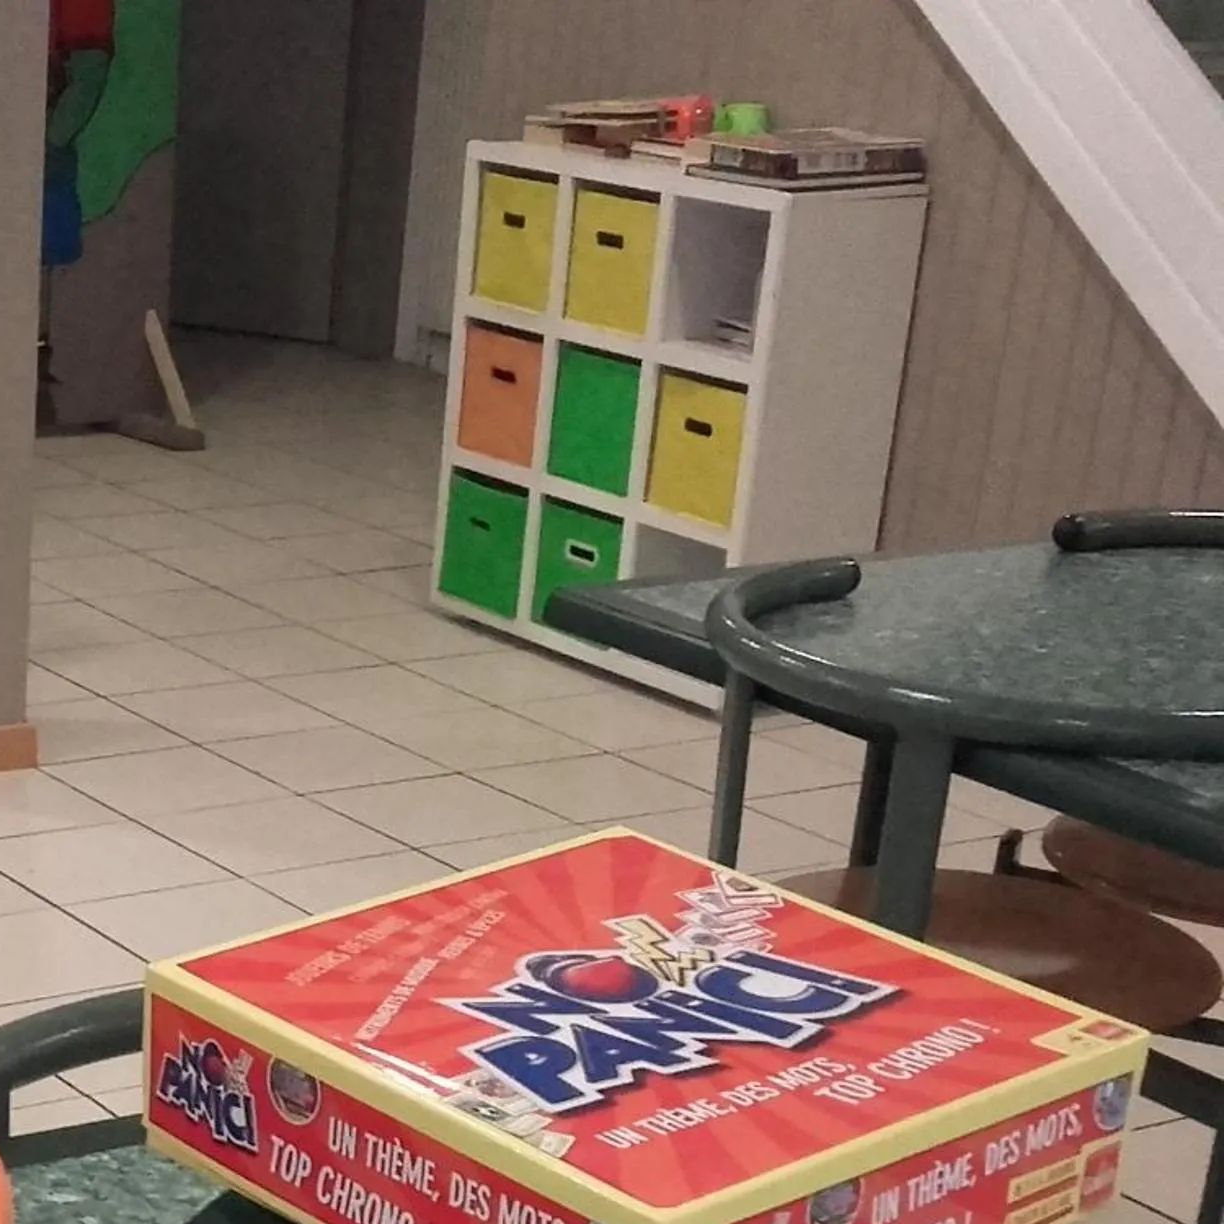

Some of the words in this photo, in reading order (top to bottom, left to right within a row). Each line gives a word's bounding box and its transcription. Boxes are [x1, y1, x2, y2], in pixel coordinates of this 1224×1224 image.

[595, 1123, 649, 1150] UN
[638, 1096, 737, 1136] THÈME,
[720, 1080, 780, 1108] DES
[770, 1055, 857, 1091] MOTS,
[813, 1073, 885, 1106] TOP
[867, 1025, 987, 1081] CHRONO
[268, 1135, 312, 1189] TOP
[328, 1116, 357, 1160] UN
[363, 1132, 440, 1203] THÈME,
[448, 1172, 491, 1222] DES
[907, 1151, 977, 1212] THÈME,
[984, 1128, 1022, 1176] DES
